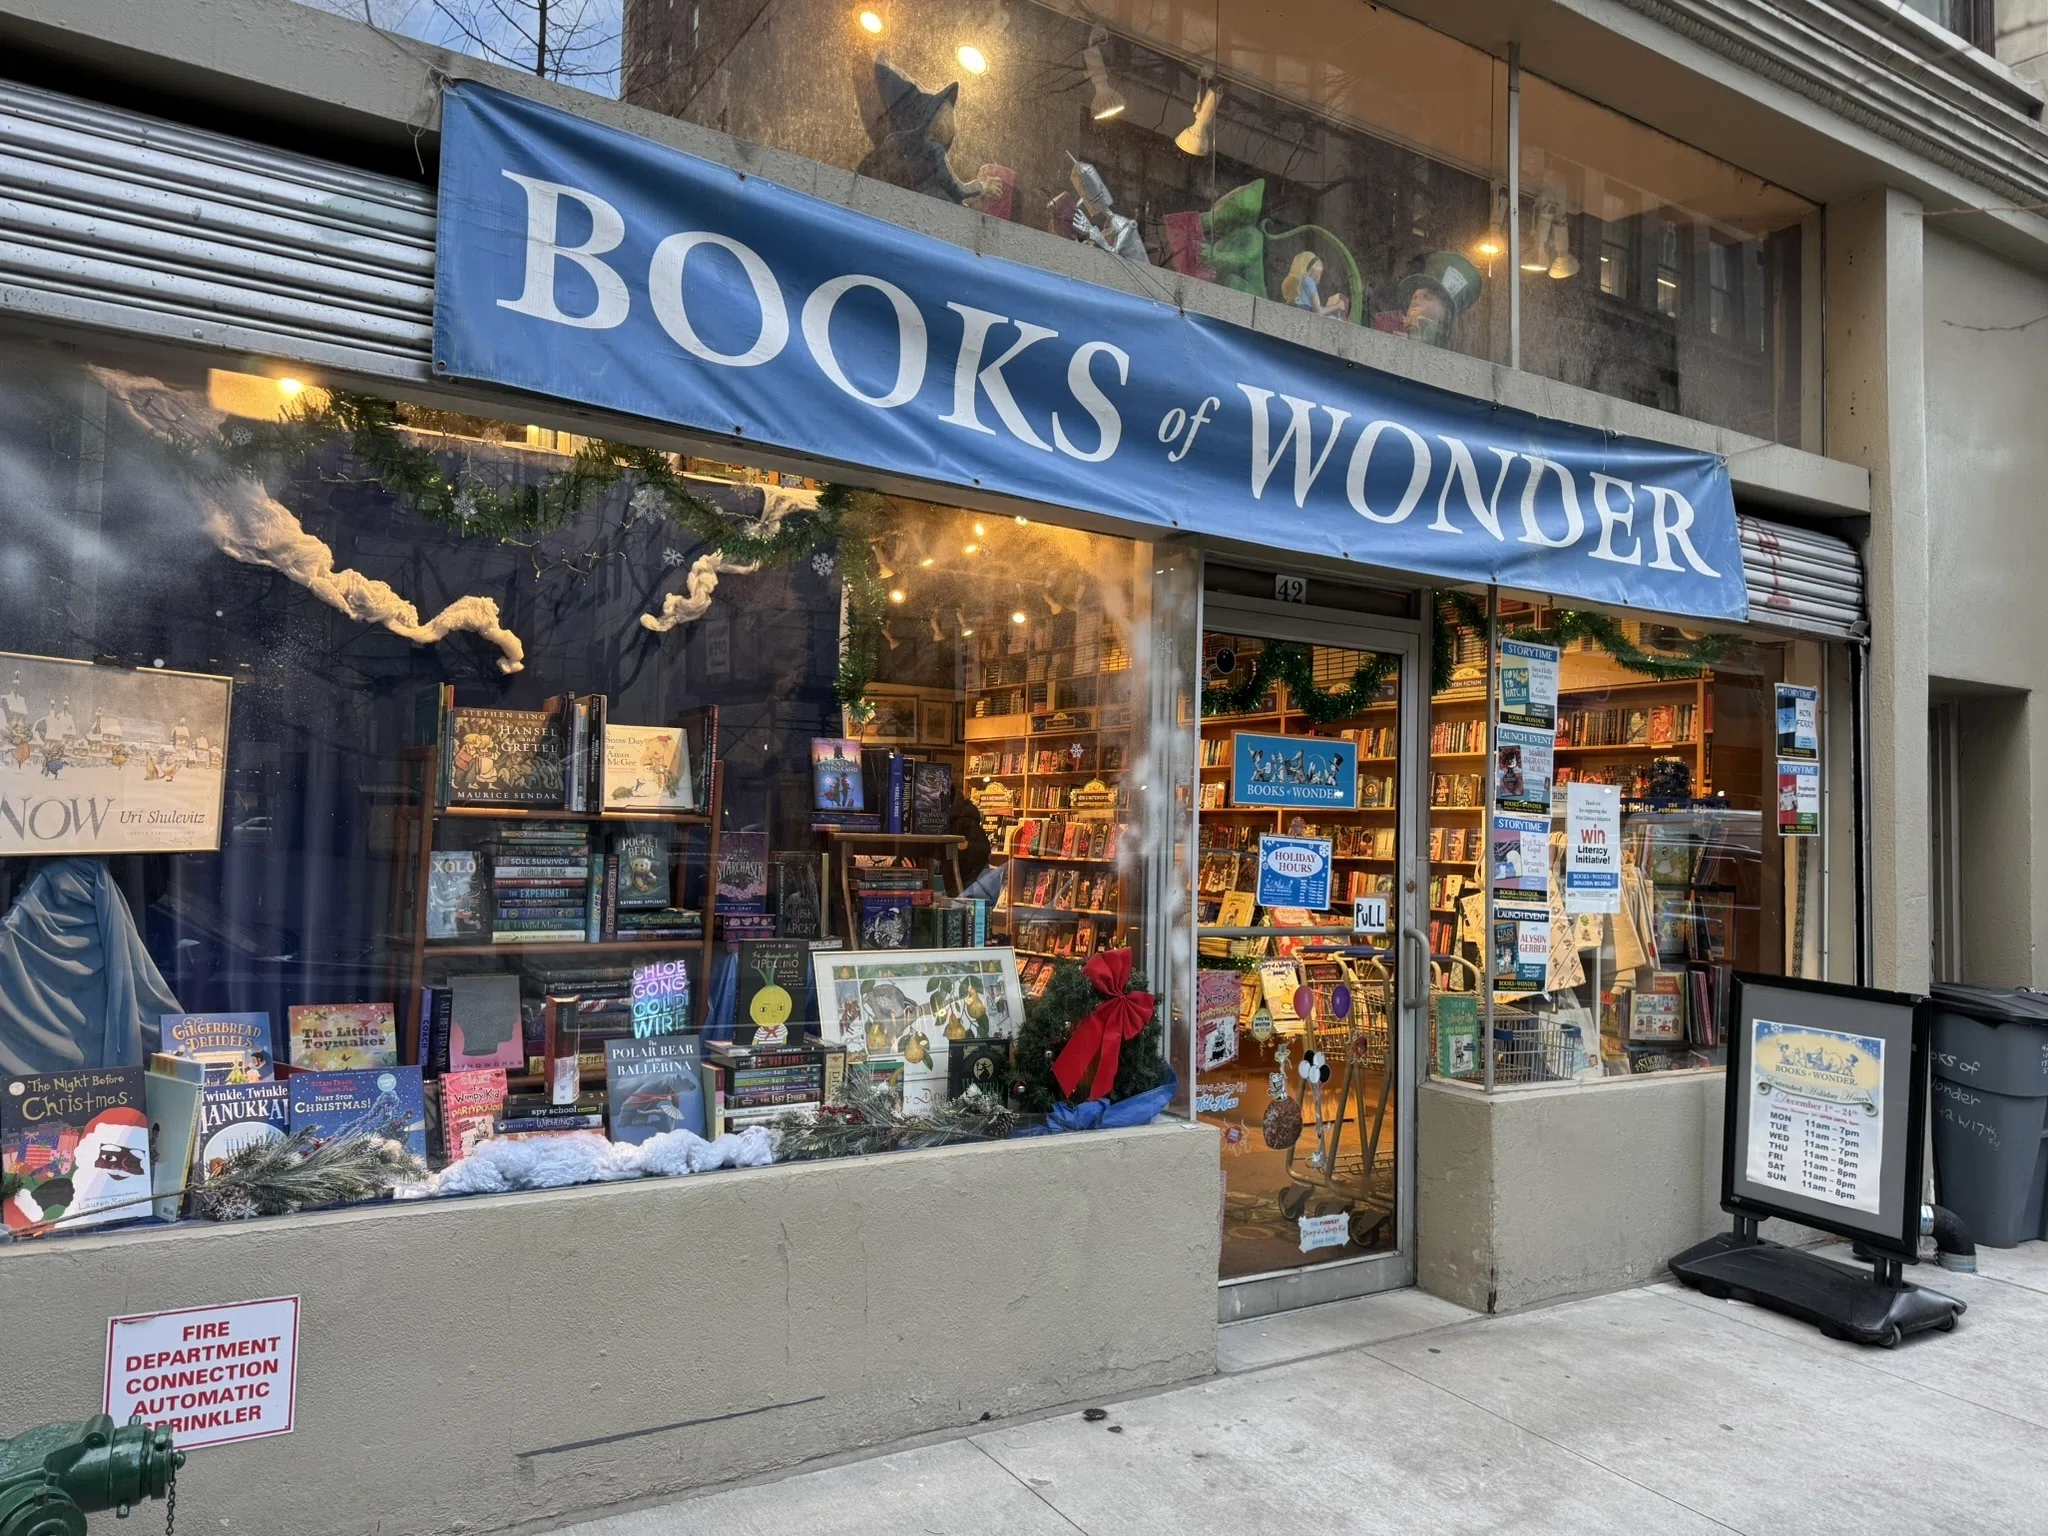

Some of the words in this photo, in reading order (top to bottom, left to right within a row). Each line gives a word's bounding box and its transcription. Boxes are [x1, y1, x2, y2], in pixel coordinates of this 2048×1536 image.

[496, 168, 1130, 463] BOOKS
[1158, 396, 1220, 463] of
[1237, 382, 1721, 578] WONDER
[1277, 580, 1303, 602] 42
[1508, 644, 1553, 660] STORYTIME
[462, 709, 513, 719] STEPHEN
[518, 711, 546, 720] KING
[500, 725, 558, 737] HANSEL
[1500, 729, 1527, 742] LAUNCH
[1529, 735, 1552, 744] EVENT
[501, 742, 558, 753] GRETEL
[628, 737, 645, 747] Day
[607, 758, 637, 766] McGee
[514, 792, 559, 800] SENDAK
[1247, 784, 1285, 796] BOOKS
[120, 810, 143, 824] Uri
[147, 810, 205, 824] Shulevitz
[1499, 819, 1543, 831] STORYTIME
[1581, 824, 1606, 845] win
[622, 836, 659, 850] POCKET
[1578, 846, 1608, 855] Literacy
[628, 846, 655, 859] BEAR
[1275, 852, 1317, 863] HOLIDAY
[1576, 855, 1610, 864] Initiative!
[432, 860, 477, 874] XOLO
[1278, 863, 1312, 873] HOURS
[520, 889, 570, 898] EXPERIMENT
[1497, 911, 1523, 919] LAUNCH
[1524, 912, 1546, 920] EVENT
[541, 921, 563, 930] Magic
[1520, 934, 1546, 943] ALYSON
[1520, 944, 1547, 953] GERBER
[633, 960, 685, 980] CHLOE
[633, 977, 685, 998] GONG
[633, 994, 685, 1017] COLD
[302, 1028, 332, 1038] The
[336, 1026, 378, 1037] Little
[634, 1012, 685, 1039] WIRE
[420, 1020, 430, 1048] COACH
[185, 1035, 253, 1051] DREIDELS
[302, 1037, 385, 1051] Toymaker
[612, 1047, 657, 1059] POLAR
[660, 1044, 694, 1056] BEAR
[617, 1061, 692, 1076] BALLERINA
[1775, 1064, 1806, 1077] BOOKS
[1813, 1071, 1857, 1086] WONDER
[1959, 1061, 1981, 1075] of
[28, 1078, 51, 1092] The
[54, 1075, 88, 1092] Night
[92, 1074, 125, 1086] Before
[315, 1094, 334, 1102] NEXT
[453, 1092, 484, 1104] Wimpy
[485, 1088, 500, 1100] Kid
[771, 1095, 785, 1103] LAST
[786, 1093, 807, 1102] EMBER
[1774, 1091, 1821, 1110] December
[22, 1091, 128, 1121] Christmas
[295, 1098, 371, 1113] CHRISTMAS!
[531, 1108, 547, 1118] spy
[549, 1106, 577, 1114] school
[1770, 1112, 1792, 1122] MON
[1805, 1120, 1830, 1131] 11am
[1840, 1127, 1860, 1137] 7pm
[1770, 1122, 1788, 1132] TUE
[1804, 1130, 1829, 1141] 11am
[1839, 1137, 1859, 1148] 7pm
[1769, 1132, 1790, 1142] WED
[1804, 1140, 1829, 1151] 11am
[1839, 1147, 1859, 1158] 7pm
[1769, 1142, 1788, 1152] THU
[1803, 1150, 1828, 1162] 11am
[1838, 1158, 1858, 1169] 8pm
[1768, 1151, 1783, 1161] FRI
[1803, 1160, 1828, 1172] 11am
[1837, 1168, 1857, 1179] 8pm
[1768, 1161, 1785, 1171] SAT
[1802, 1170, 1827, 1182] 11am
[1836, 1178, 1856, 1190] 8pm
[1767, 1171, 1787, 1182] SUN
[1801, 1180, 1826, 1193] 11am
[1835, 1189, 1855, 1200] 8pm
[78, 1200, 106, 1211] Lauren
[182, 1321, 231, 1342] FIRE
[125, 1336, 281, 1373] DEPARTMENT
[125, 1358, 280, 1395] CONNECTION
[133, 1382, 271, 1416] AUTOMATIC
